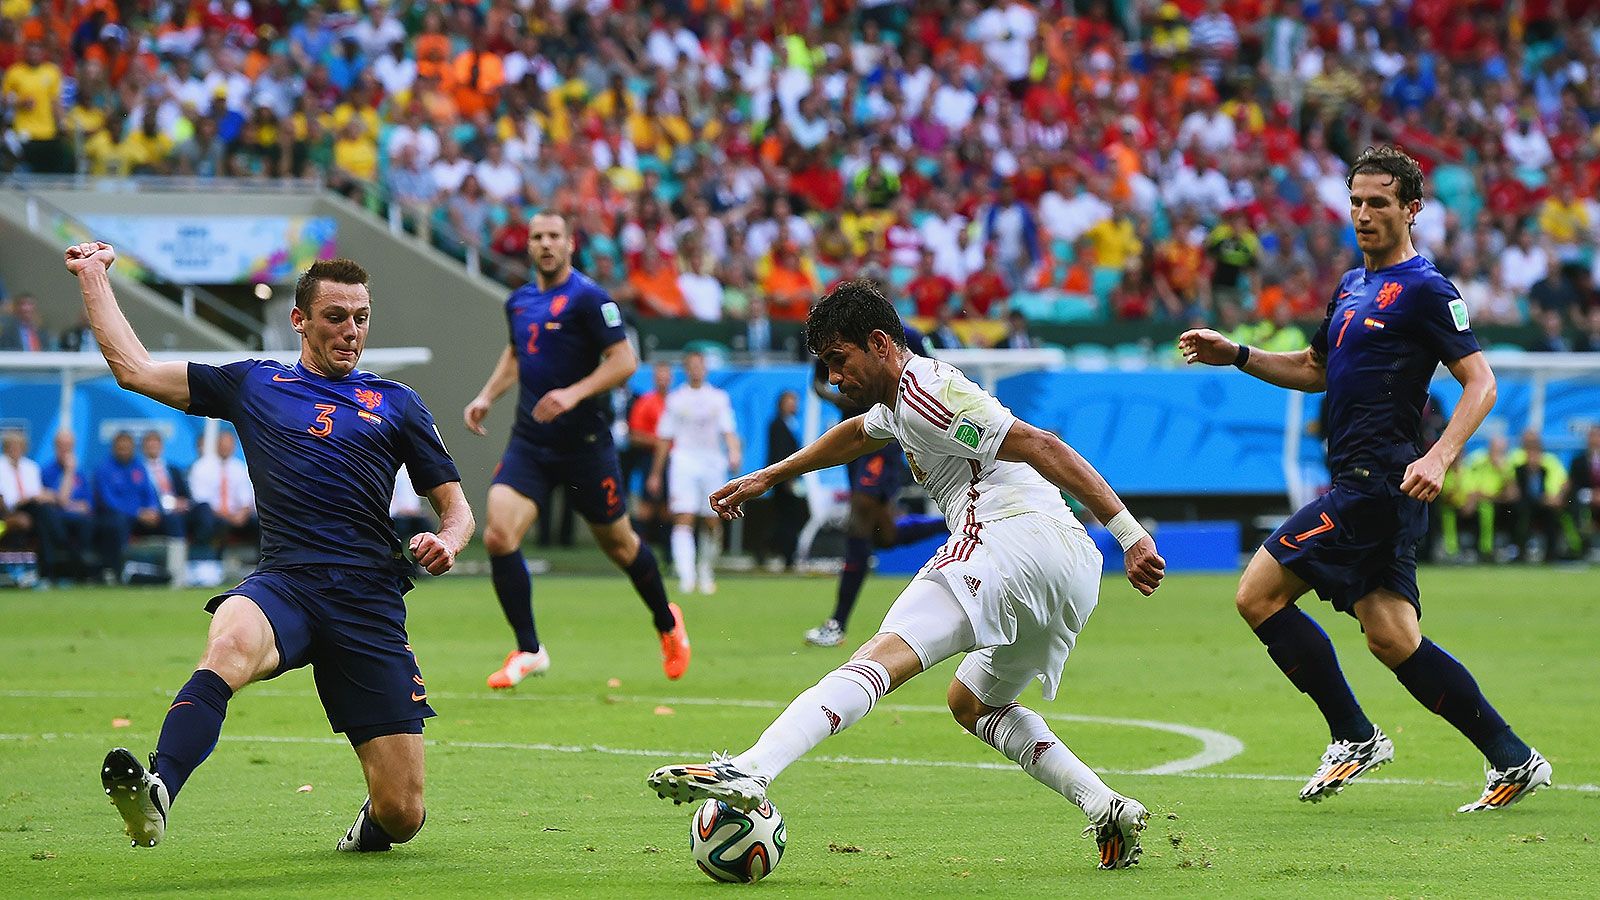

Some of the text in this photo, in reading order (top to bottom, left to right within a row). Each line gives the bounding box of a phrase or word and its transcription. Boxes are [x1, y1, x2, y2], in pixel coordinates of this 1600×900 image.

[527, 323, 540, 355] 2
[1336, 310, 1356, 348] 7
[306, 403, 337, 438] 3
[600, 475, 618, 506] 2
[1294, 511, 1336, 542] 7
